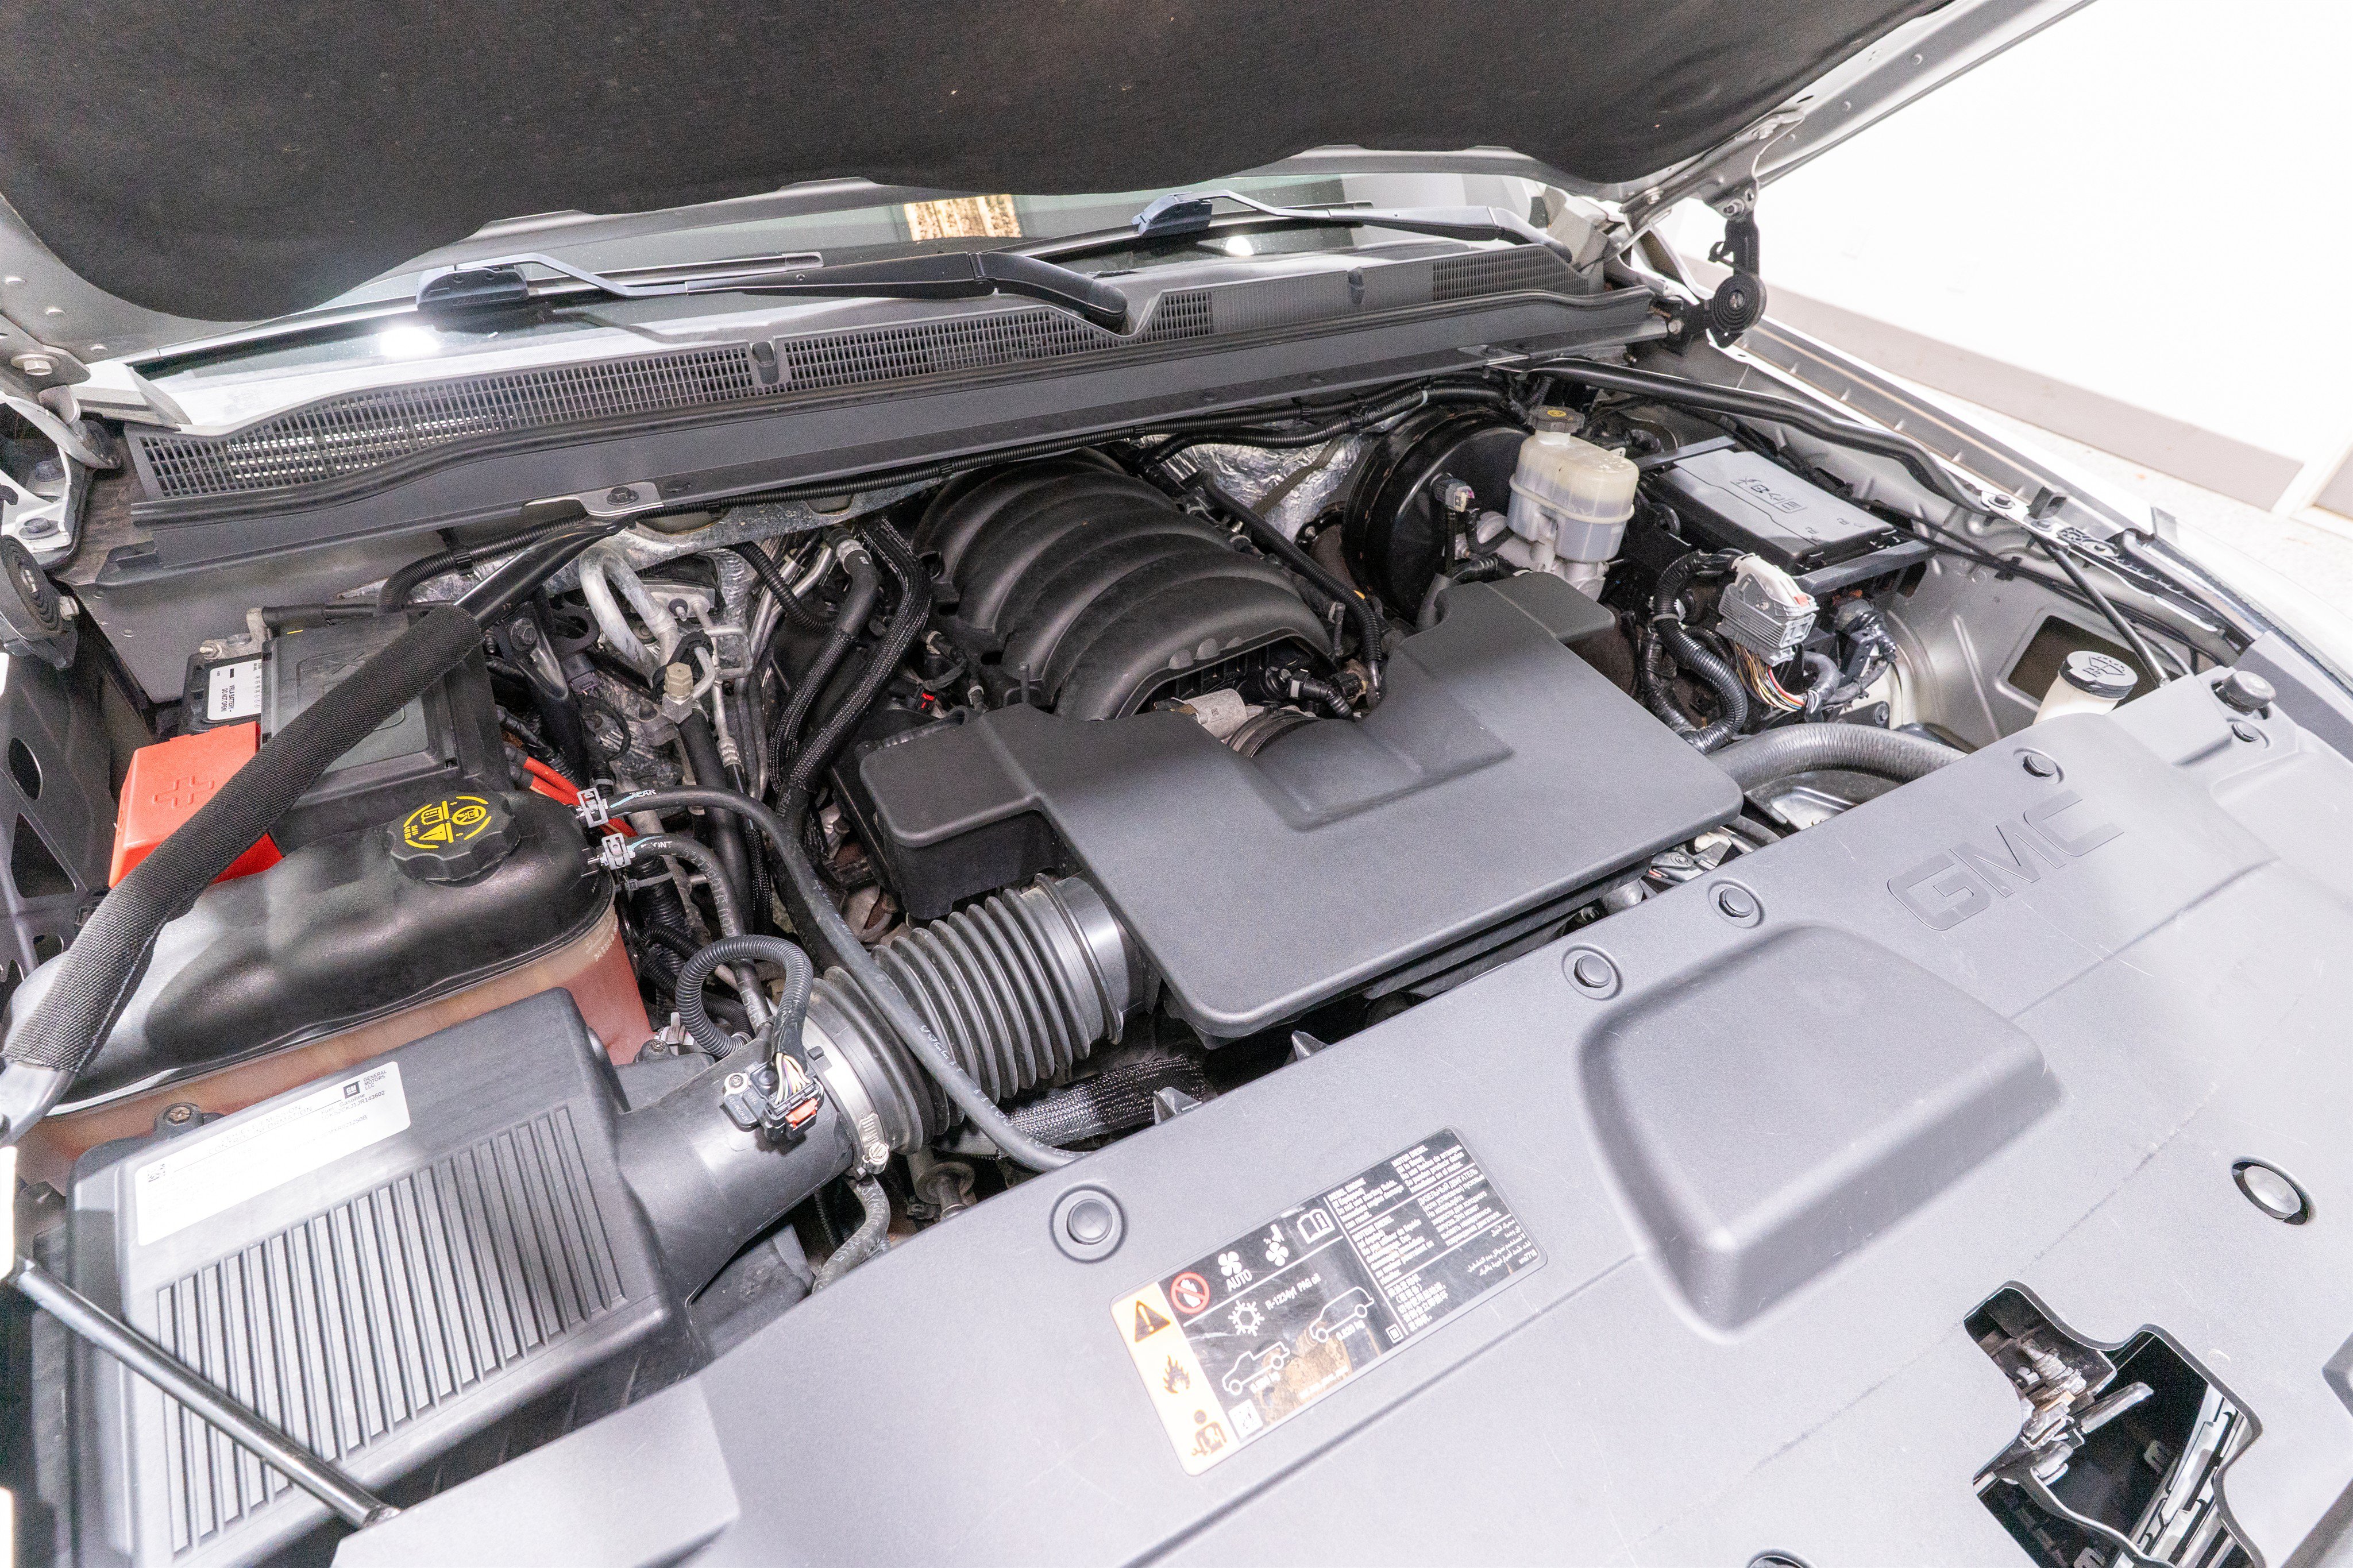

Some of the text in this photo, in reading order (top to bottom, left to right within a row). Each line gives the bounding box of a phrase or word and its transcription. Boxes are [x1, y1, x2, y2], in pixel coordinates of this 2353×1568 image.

[1887, 789, 2124, 931] GMC
[362, 1068, 387, 1082] GENERAL
[364, 1073, 385, 1086] MOTORS
[345, 1084, 357, 1096] GM
[364, 1082, 375, 1090] LLC
[339, 1092, 365, 1107] Gasoline
[1391, 1145, 1428, 1167] MOTOR DIESEL
[1417, 1159, 1434, 1171] fluidos
[1429, 1159, 1449, 1174] producir
[1327, 1177, 1365, 1202] DIESEL ENGINE
[1417, 1168, 1478, 1206] ДИЗЕЛЬНЫЙ ДВИГАТЕЛЬ
[1336, 1207, 1345, 1215] Do
[1344, 1202, 1354, 1211] not
[1352, 1198, 1363, 1206] use
[1362, 1187, 1383, 1201] starting
[1367, 1193, 1384, 1208] engine
[1381, 1184, 1403, 1199] damage
[1345, 1220, 1356, 1229] can
[1374, 1215, 1394, 1230] DIESEL
[1226, 1269, 1252, 1292] AUTO
[1265, 1286, 1297, 1310] R-1234yf
[1297, 1278, 1312, 1292] PAG
[1353, 1316, 1365, 1330] kg
